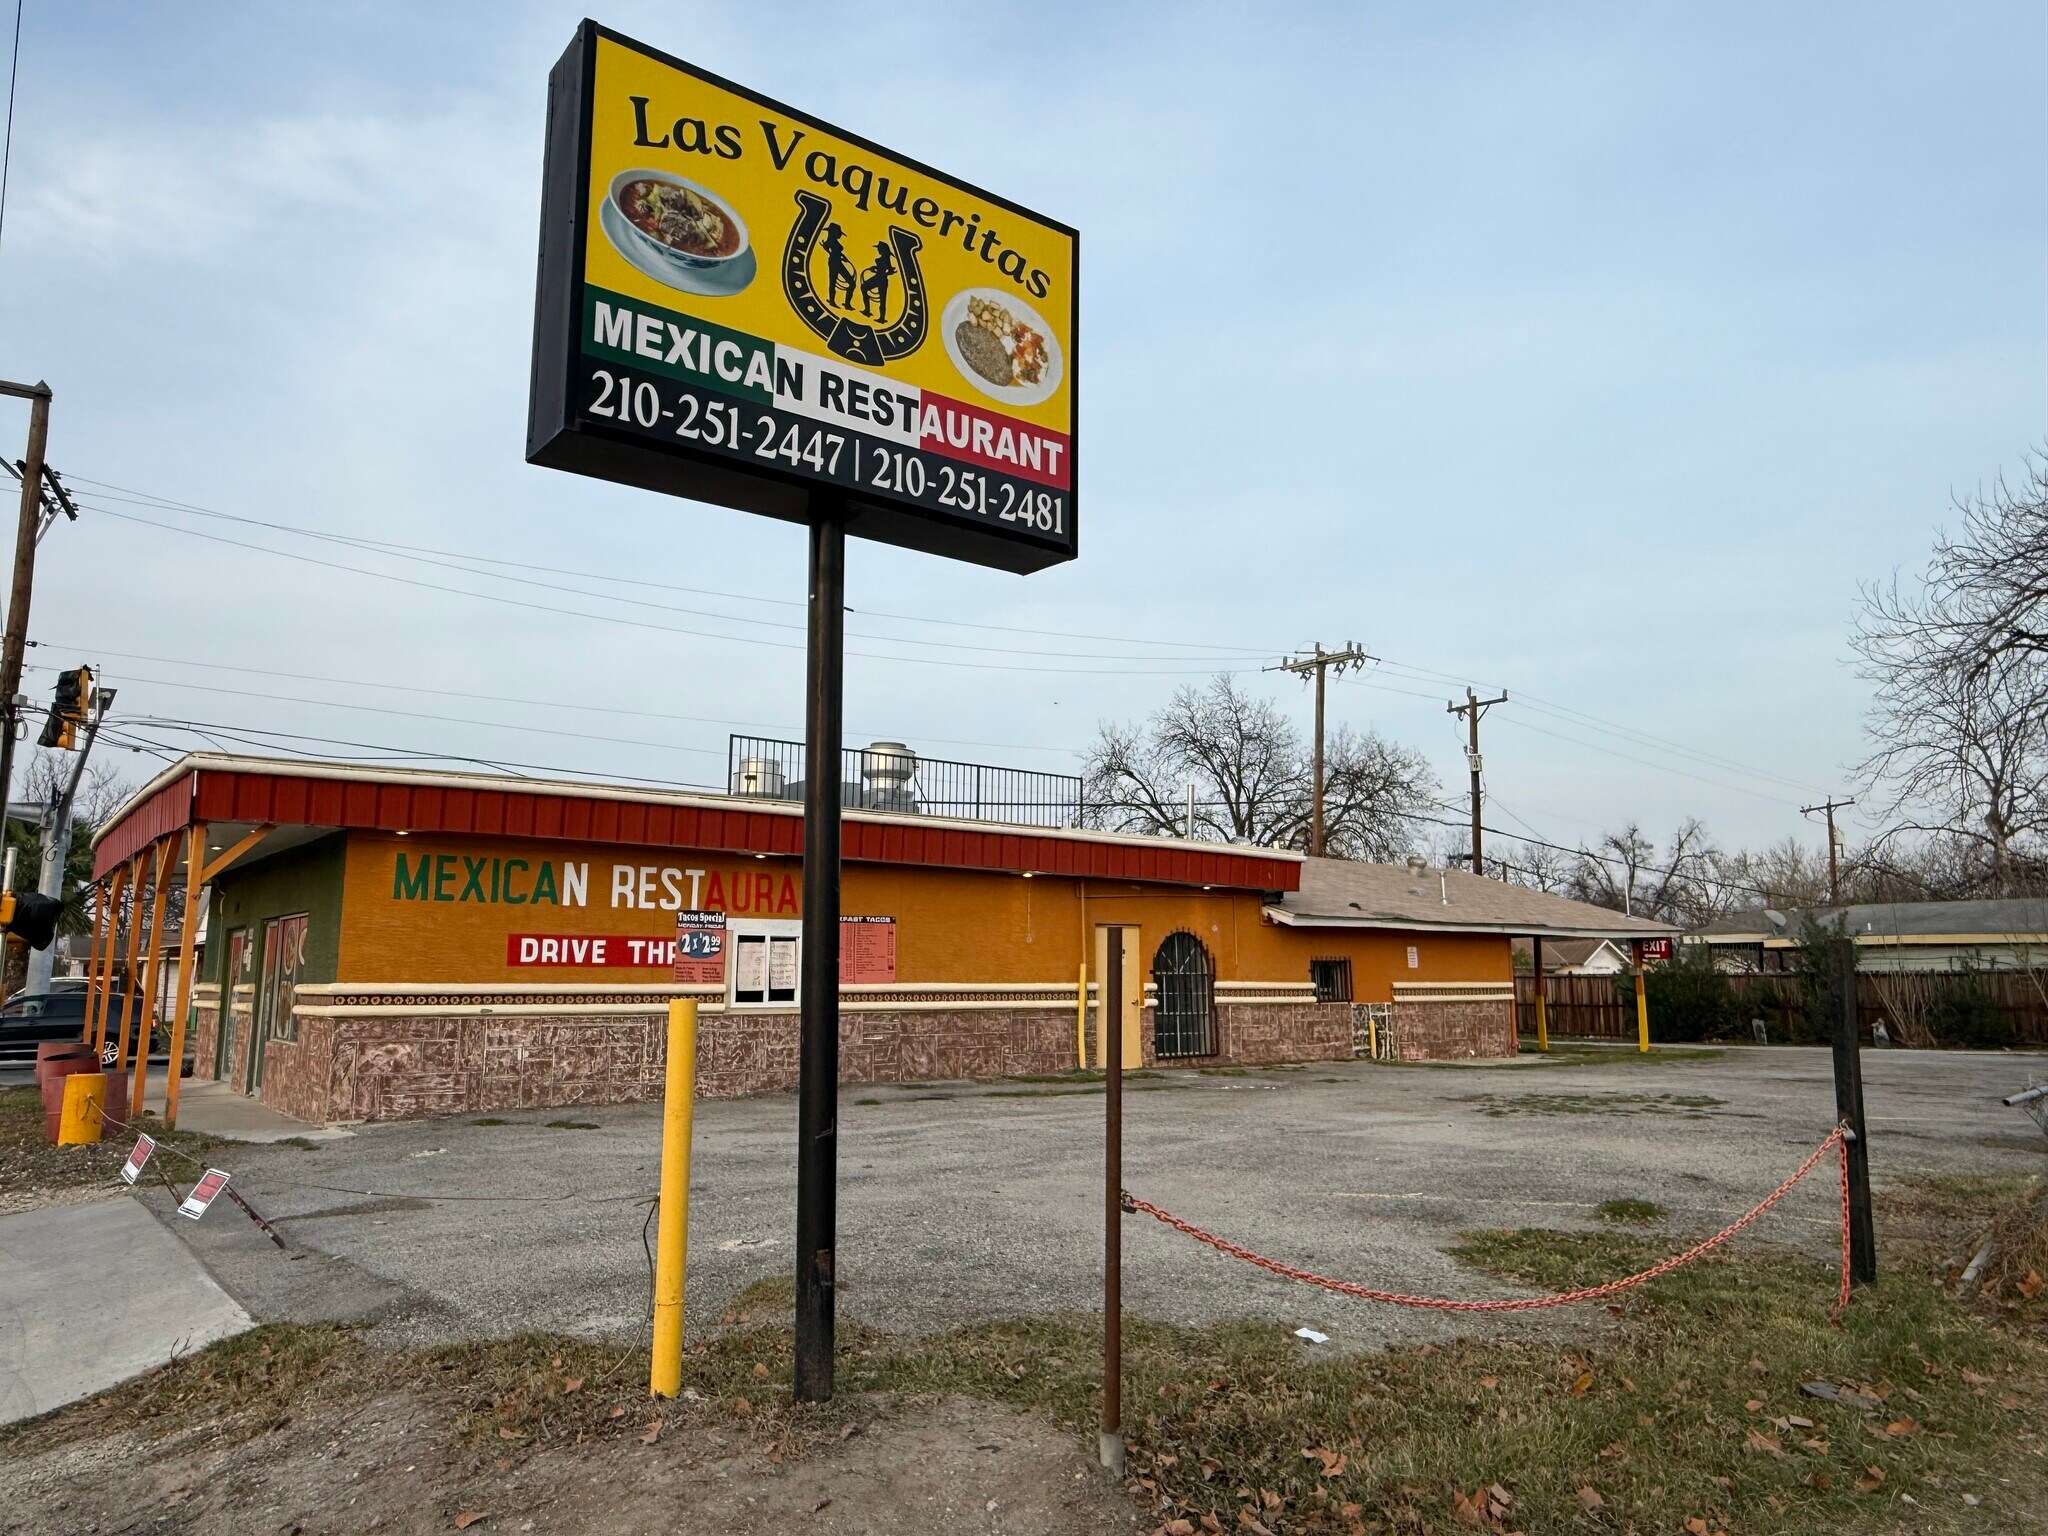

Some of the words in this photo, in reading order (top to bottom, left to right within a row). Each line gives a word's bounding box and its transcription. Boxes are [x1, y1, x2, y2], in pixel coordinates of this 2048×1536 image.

[629, 96, 742, 160] Las
[759, 121, 1052, 299] Vaqueritas
[593, 301, 803, 402] MEXICAN
[820, 369, 1063, 476] RESTAURANT
[588, 371, 845, 476] 210-251-2447
[871, 446, 1063, 535] 210-251-2481
[393, 853, 588, 907] MEXICAN
[611, 864, 798, 913] RESTAURA
[678, 912, 699, 922] Tacos
[700, 911, 725, 923] Special
[520, 938, 606, 964] DRIVE
[681, 933, 691, 953] 2
[1643, 941, 1667, 951] EXIT
